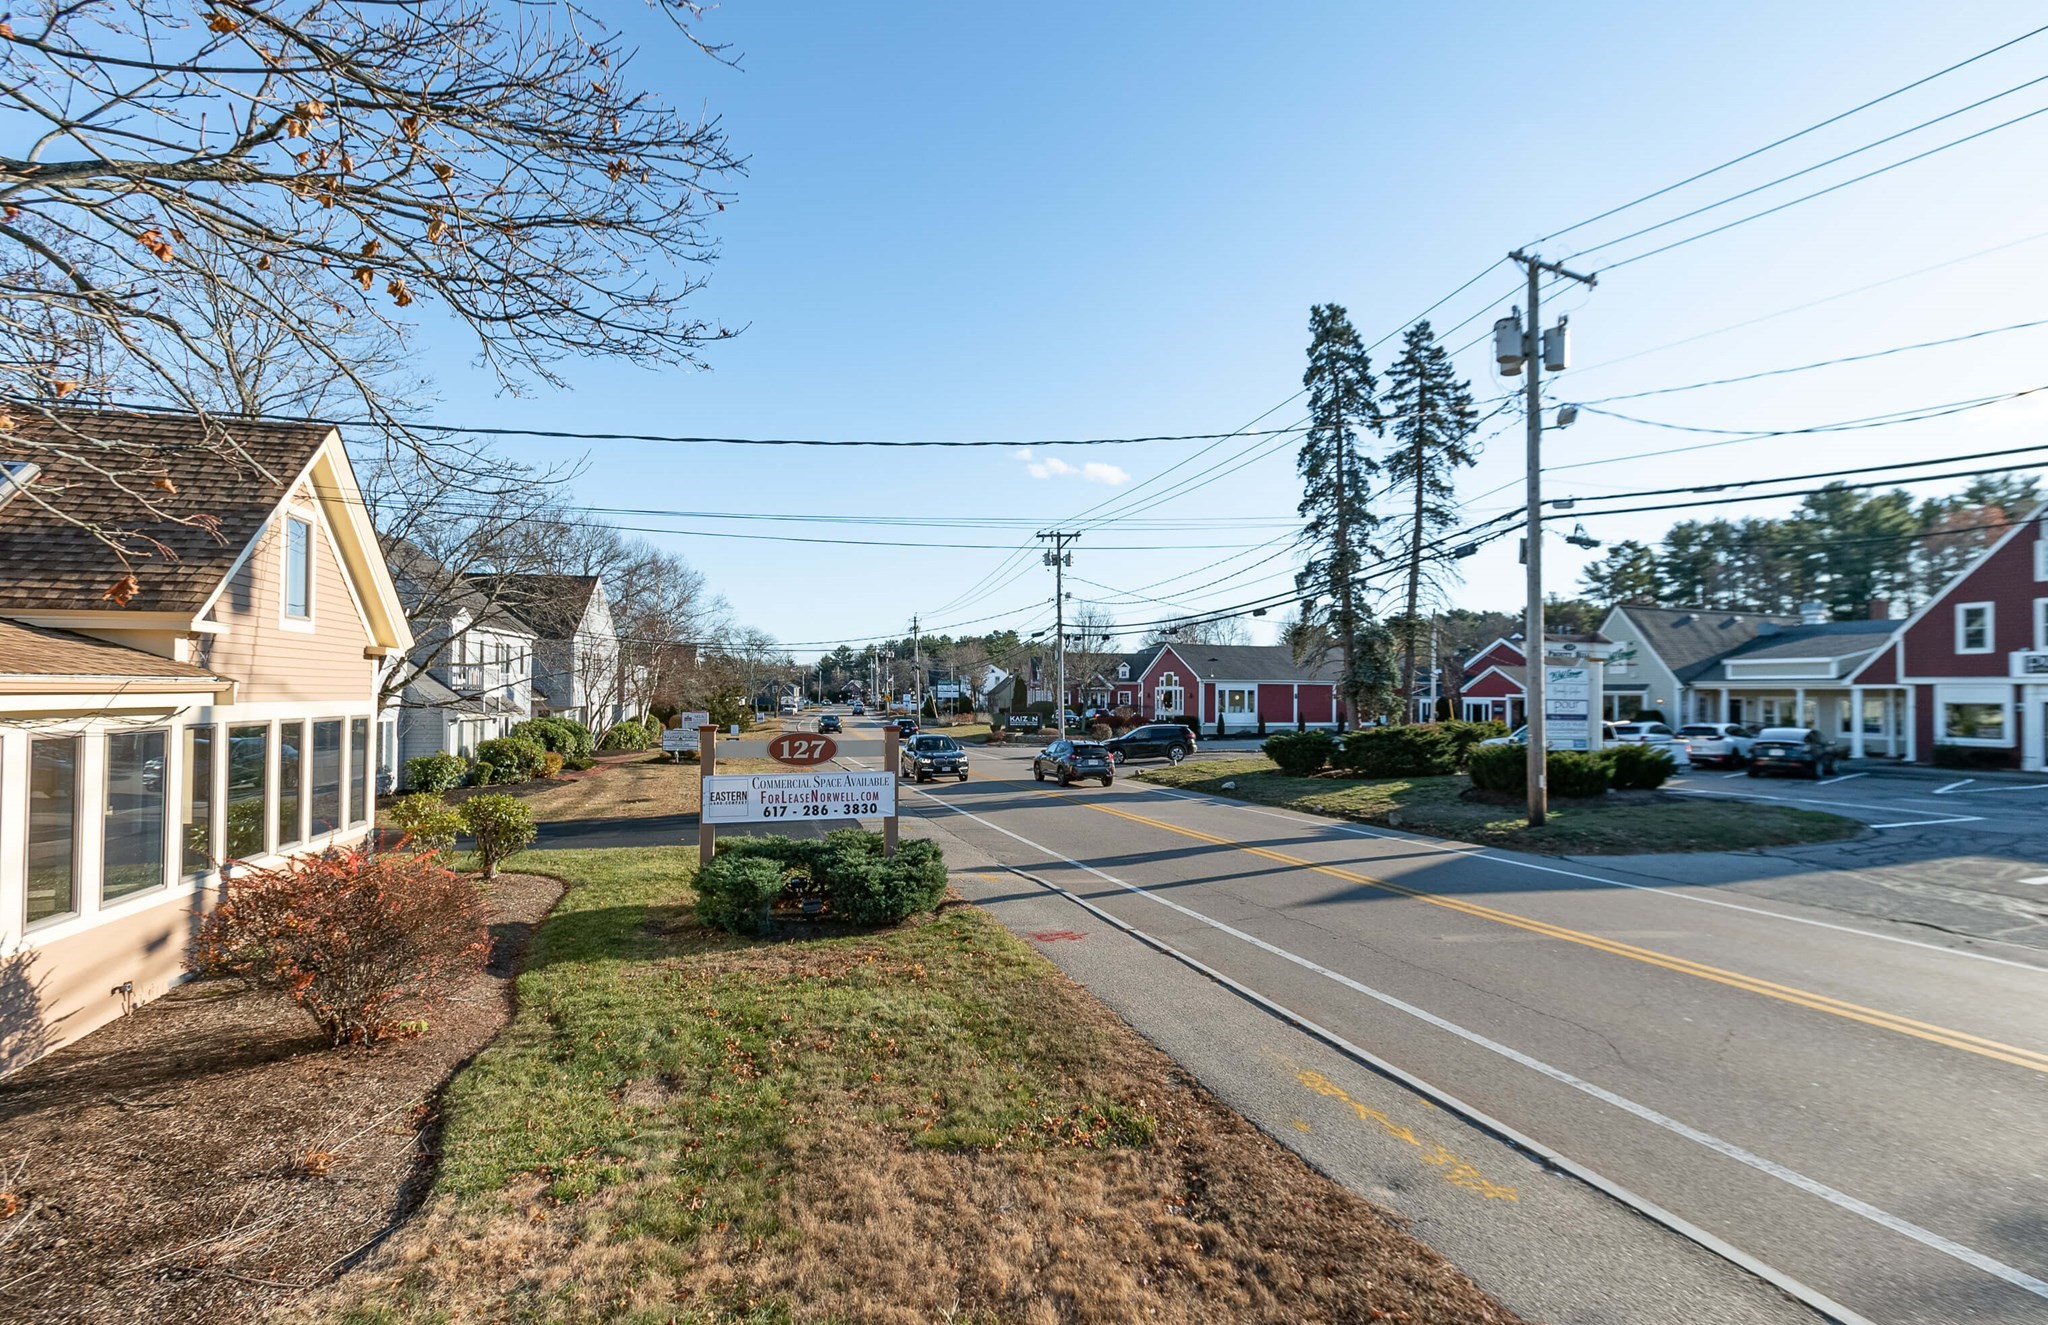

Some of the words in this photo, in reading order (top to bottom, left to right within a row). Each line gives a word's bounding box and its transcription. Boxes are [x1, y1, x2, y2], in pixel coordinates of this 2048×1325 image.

[780, 740, 826, 759] 127
[752, 776, 811, 790] COMMERCIAL
[813, 775, 842, 788] SPACE
[843, 775, 890, 788] AVAILABLE
[710, 791, 748, 802] EASTERN
[763, 806, 788, 818] 617
[803, 804, 829, 816] 286
[843, 803, 878, 815] 3830
